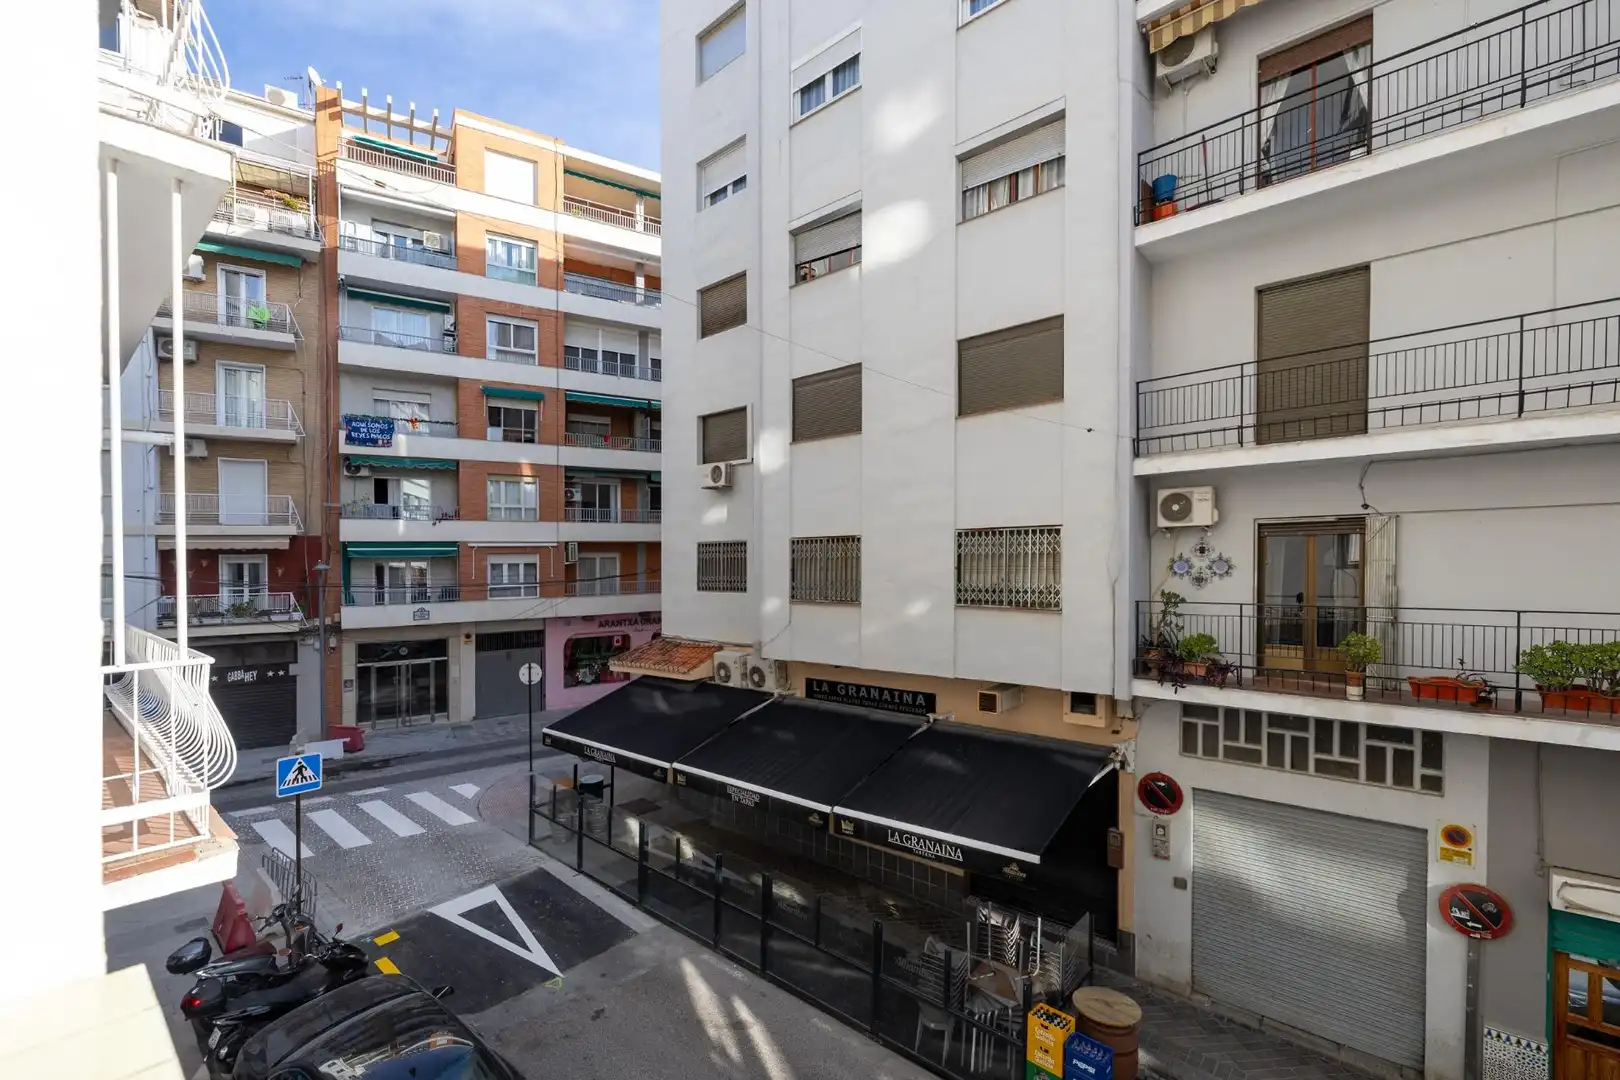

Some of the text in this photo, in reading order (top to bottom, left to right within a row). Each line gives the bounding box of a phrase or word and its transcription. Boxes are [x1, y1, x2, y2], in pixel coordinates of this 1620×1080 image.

[598, 618, 639, 629] ARANTXA
[244, 670, 258, 682] HEY
[813, 680, 830, 693] LA
[837, 683, 926, 707] GRANAINA
[888, 829, 963, 861] LA GRANAINA
[1072, 1058, 1096, 1075] PEPSI
